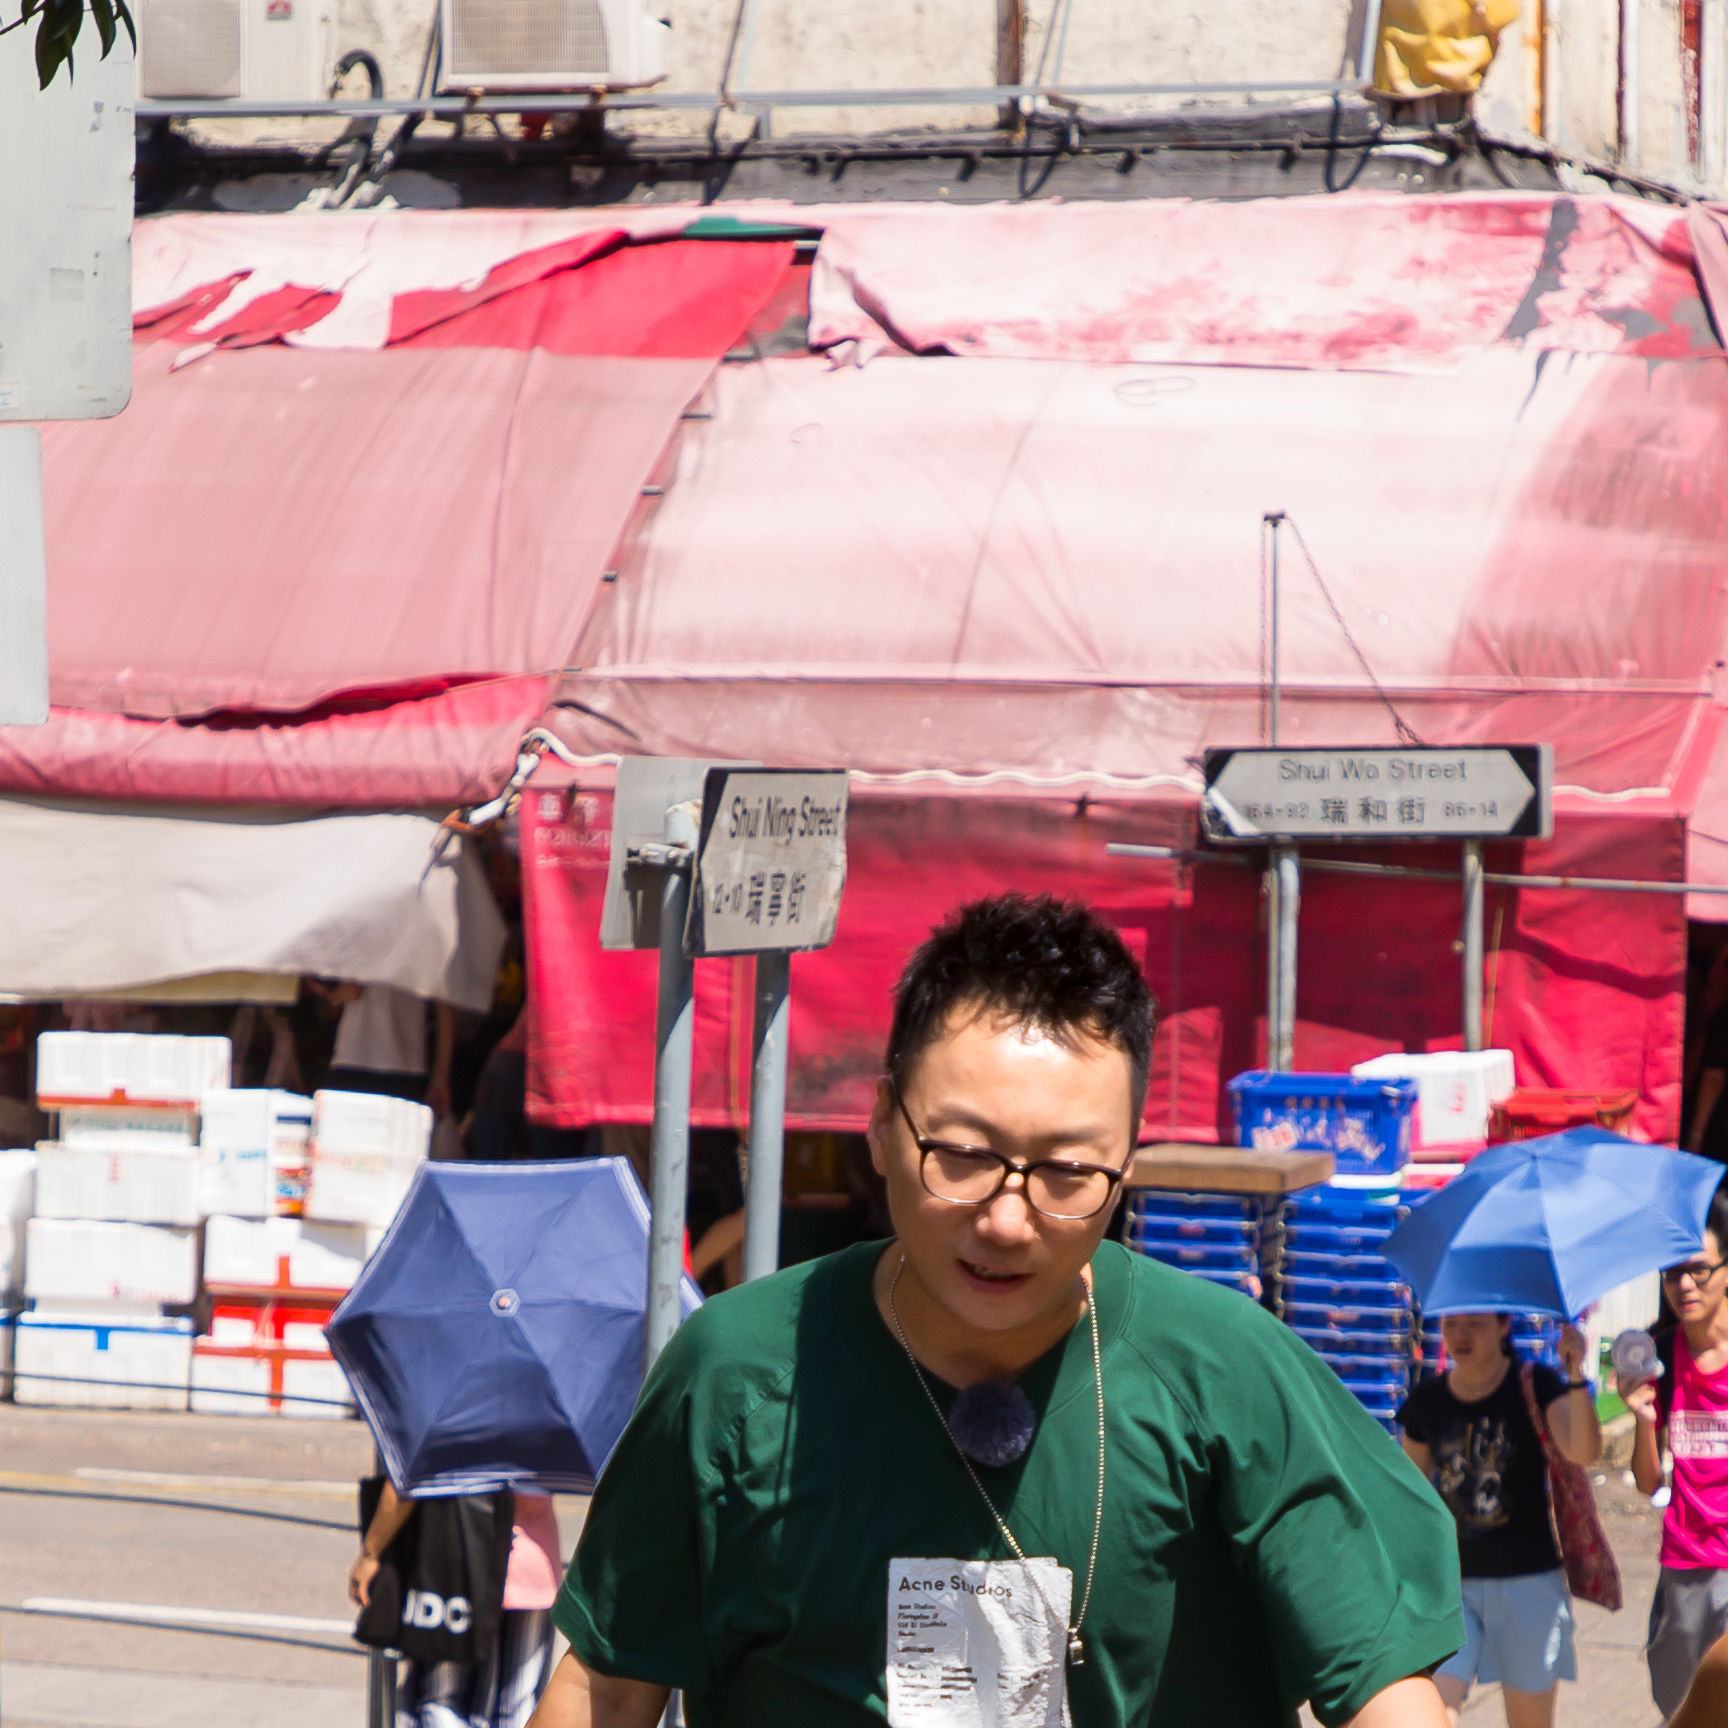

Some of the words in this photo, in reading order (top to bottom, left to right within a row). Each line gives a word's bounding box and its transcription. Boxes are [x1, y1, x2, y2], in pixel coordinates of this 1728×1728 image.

[1278, 758, 1330, 782] Shui
[1339, 758, 1380, 782] Wo
[1389, 758, 1467, 782] Street
[729, 795, 762, 838] Shui
[761, 795, 797, 846] Ning
[798, 795, 843, 838] Street
[1319, 797, 1426, 825] 瑞和街
[898, 1576, 946, 1592] Acne
[950, 1575, 1013, 1598] Studios
